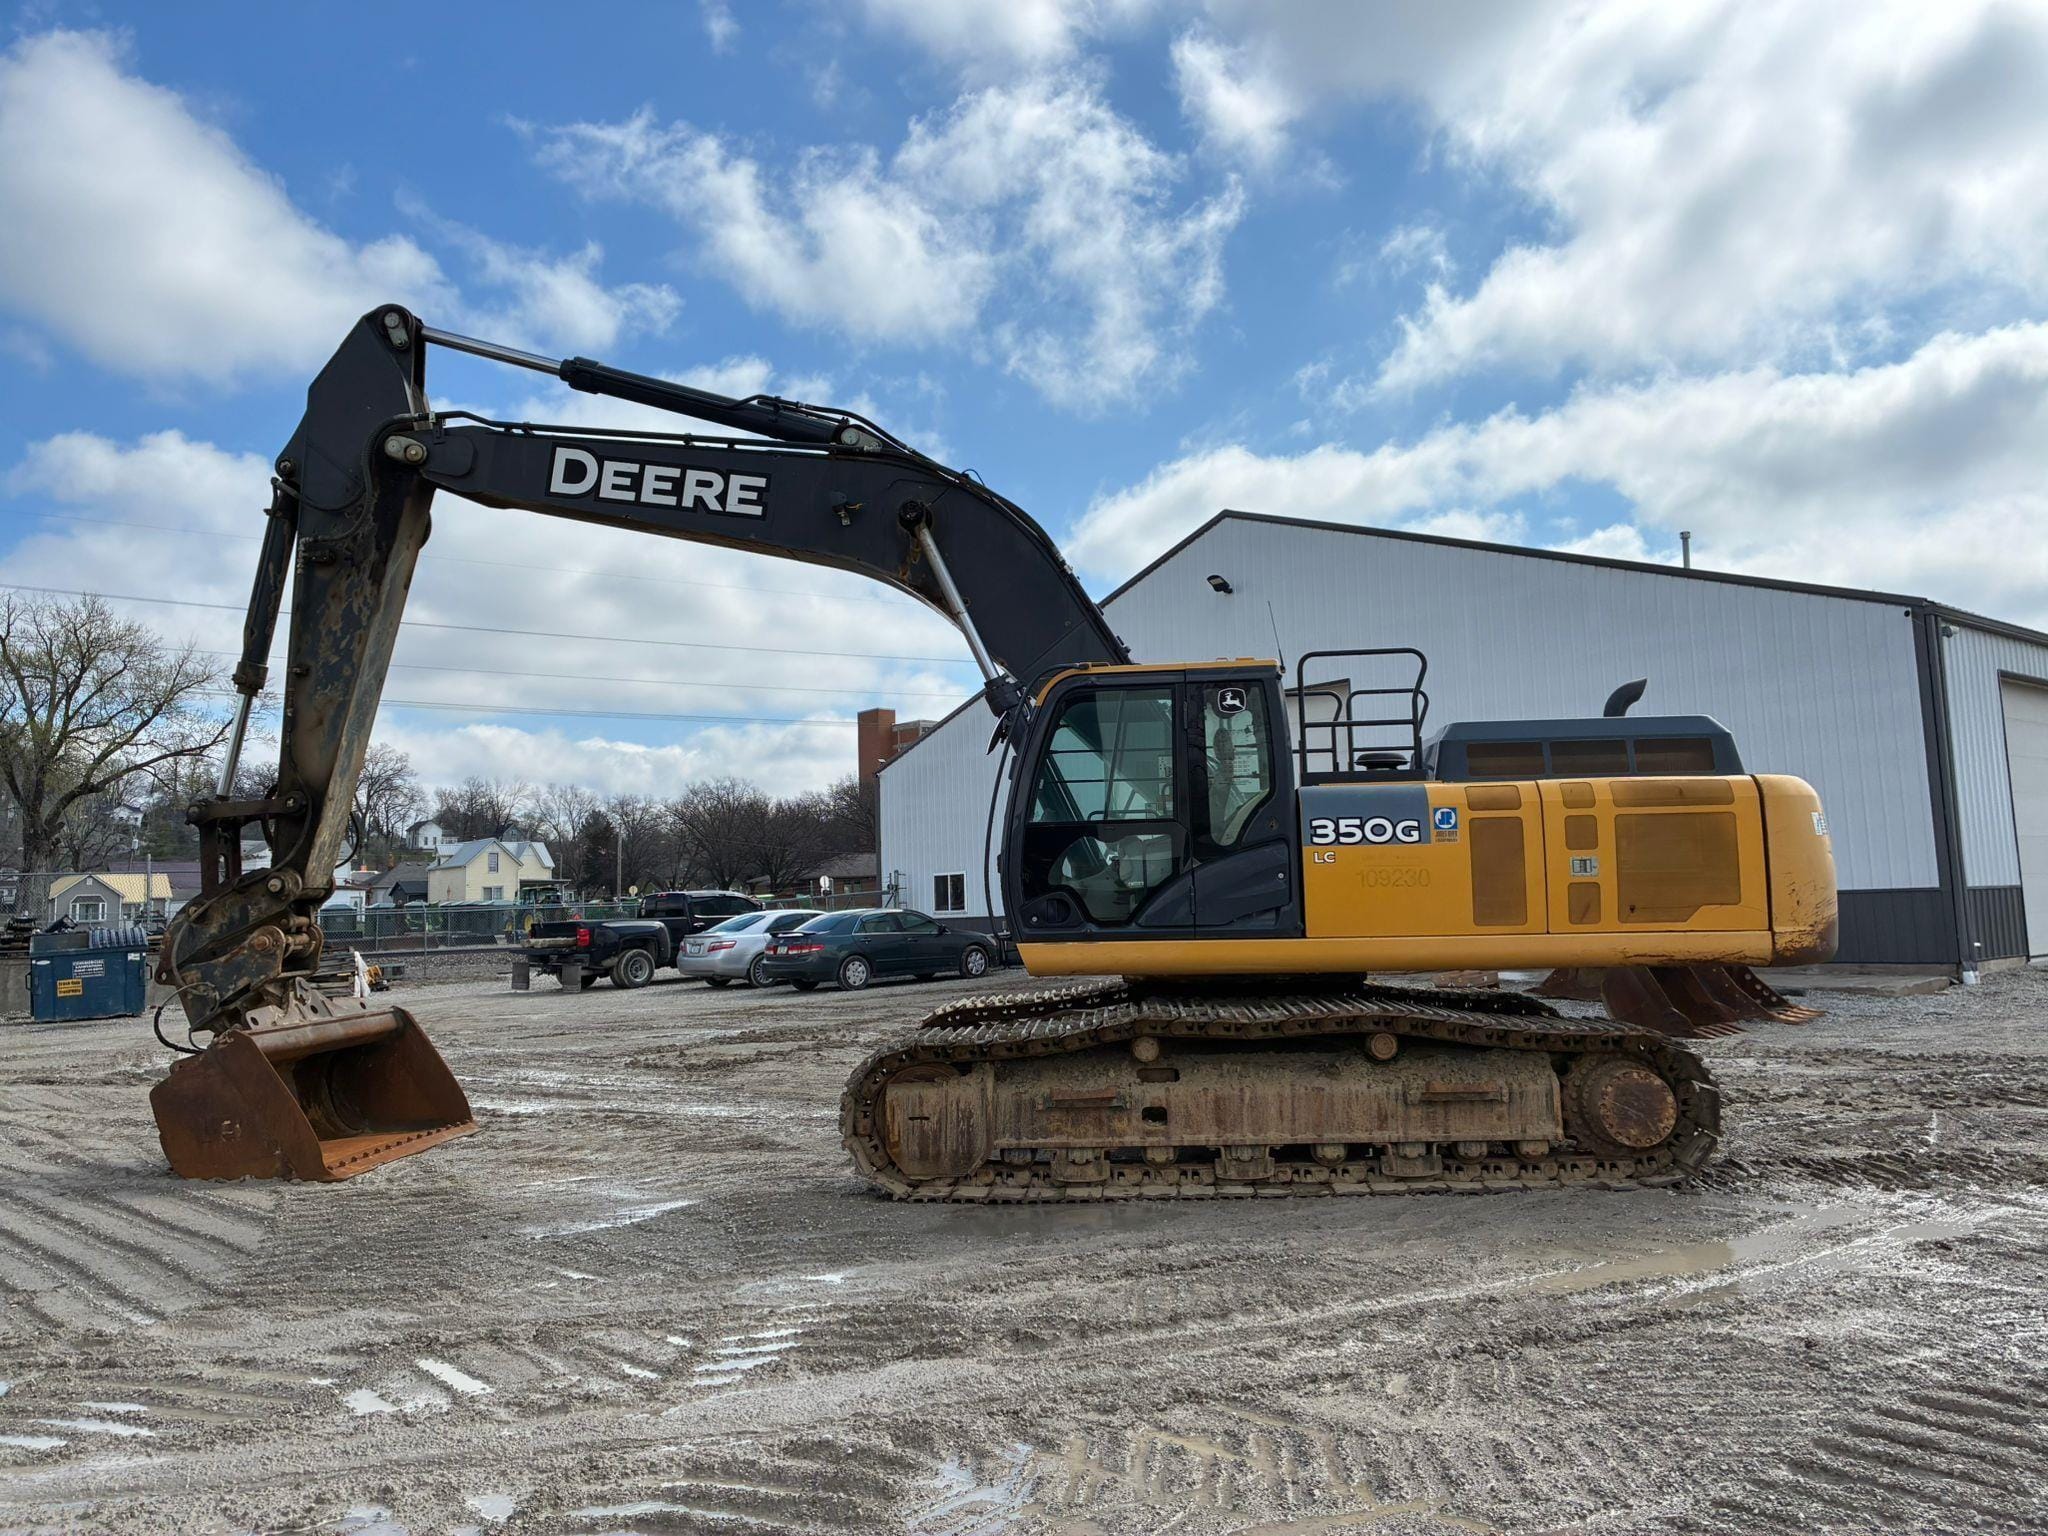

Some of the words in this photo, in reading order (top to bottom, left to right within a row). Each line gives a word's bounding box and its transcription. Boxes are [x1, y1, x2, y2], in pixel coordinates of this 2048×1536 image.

[549, 446, 768, 516] DEERE
[1311, 817, 1420, 844] 350G
[1314, 852, 1336, 863] LC
